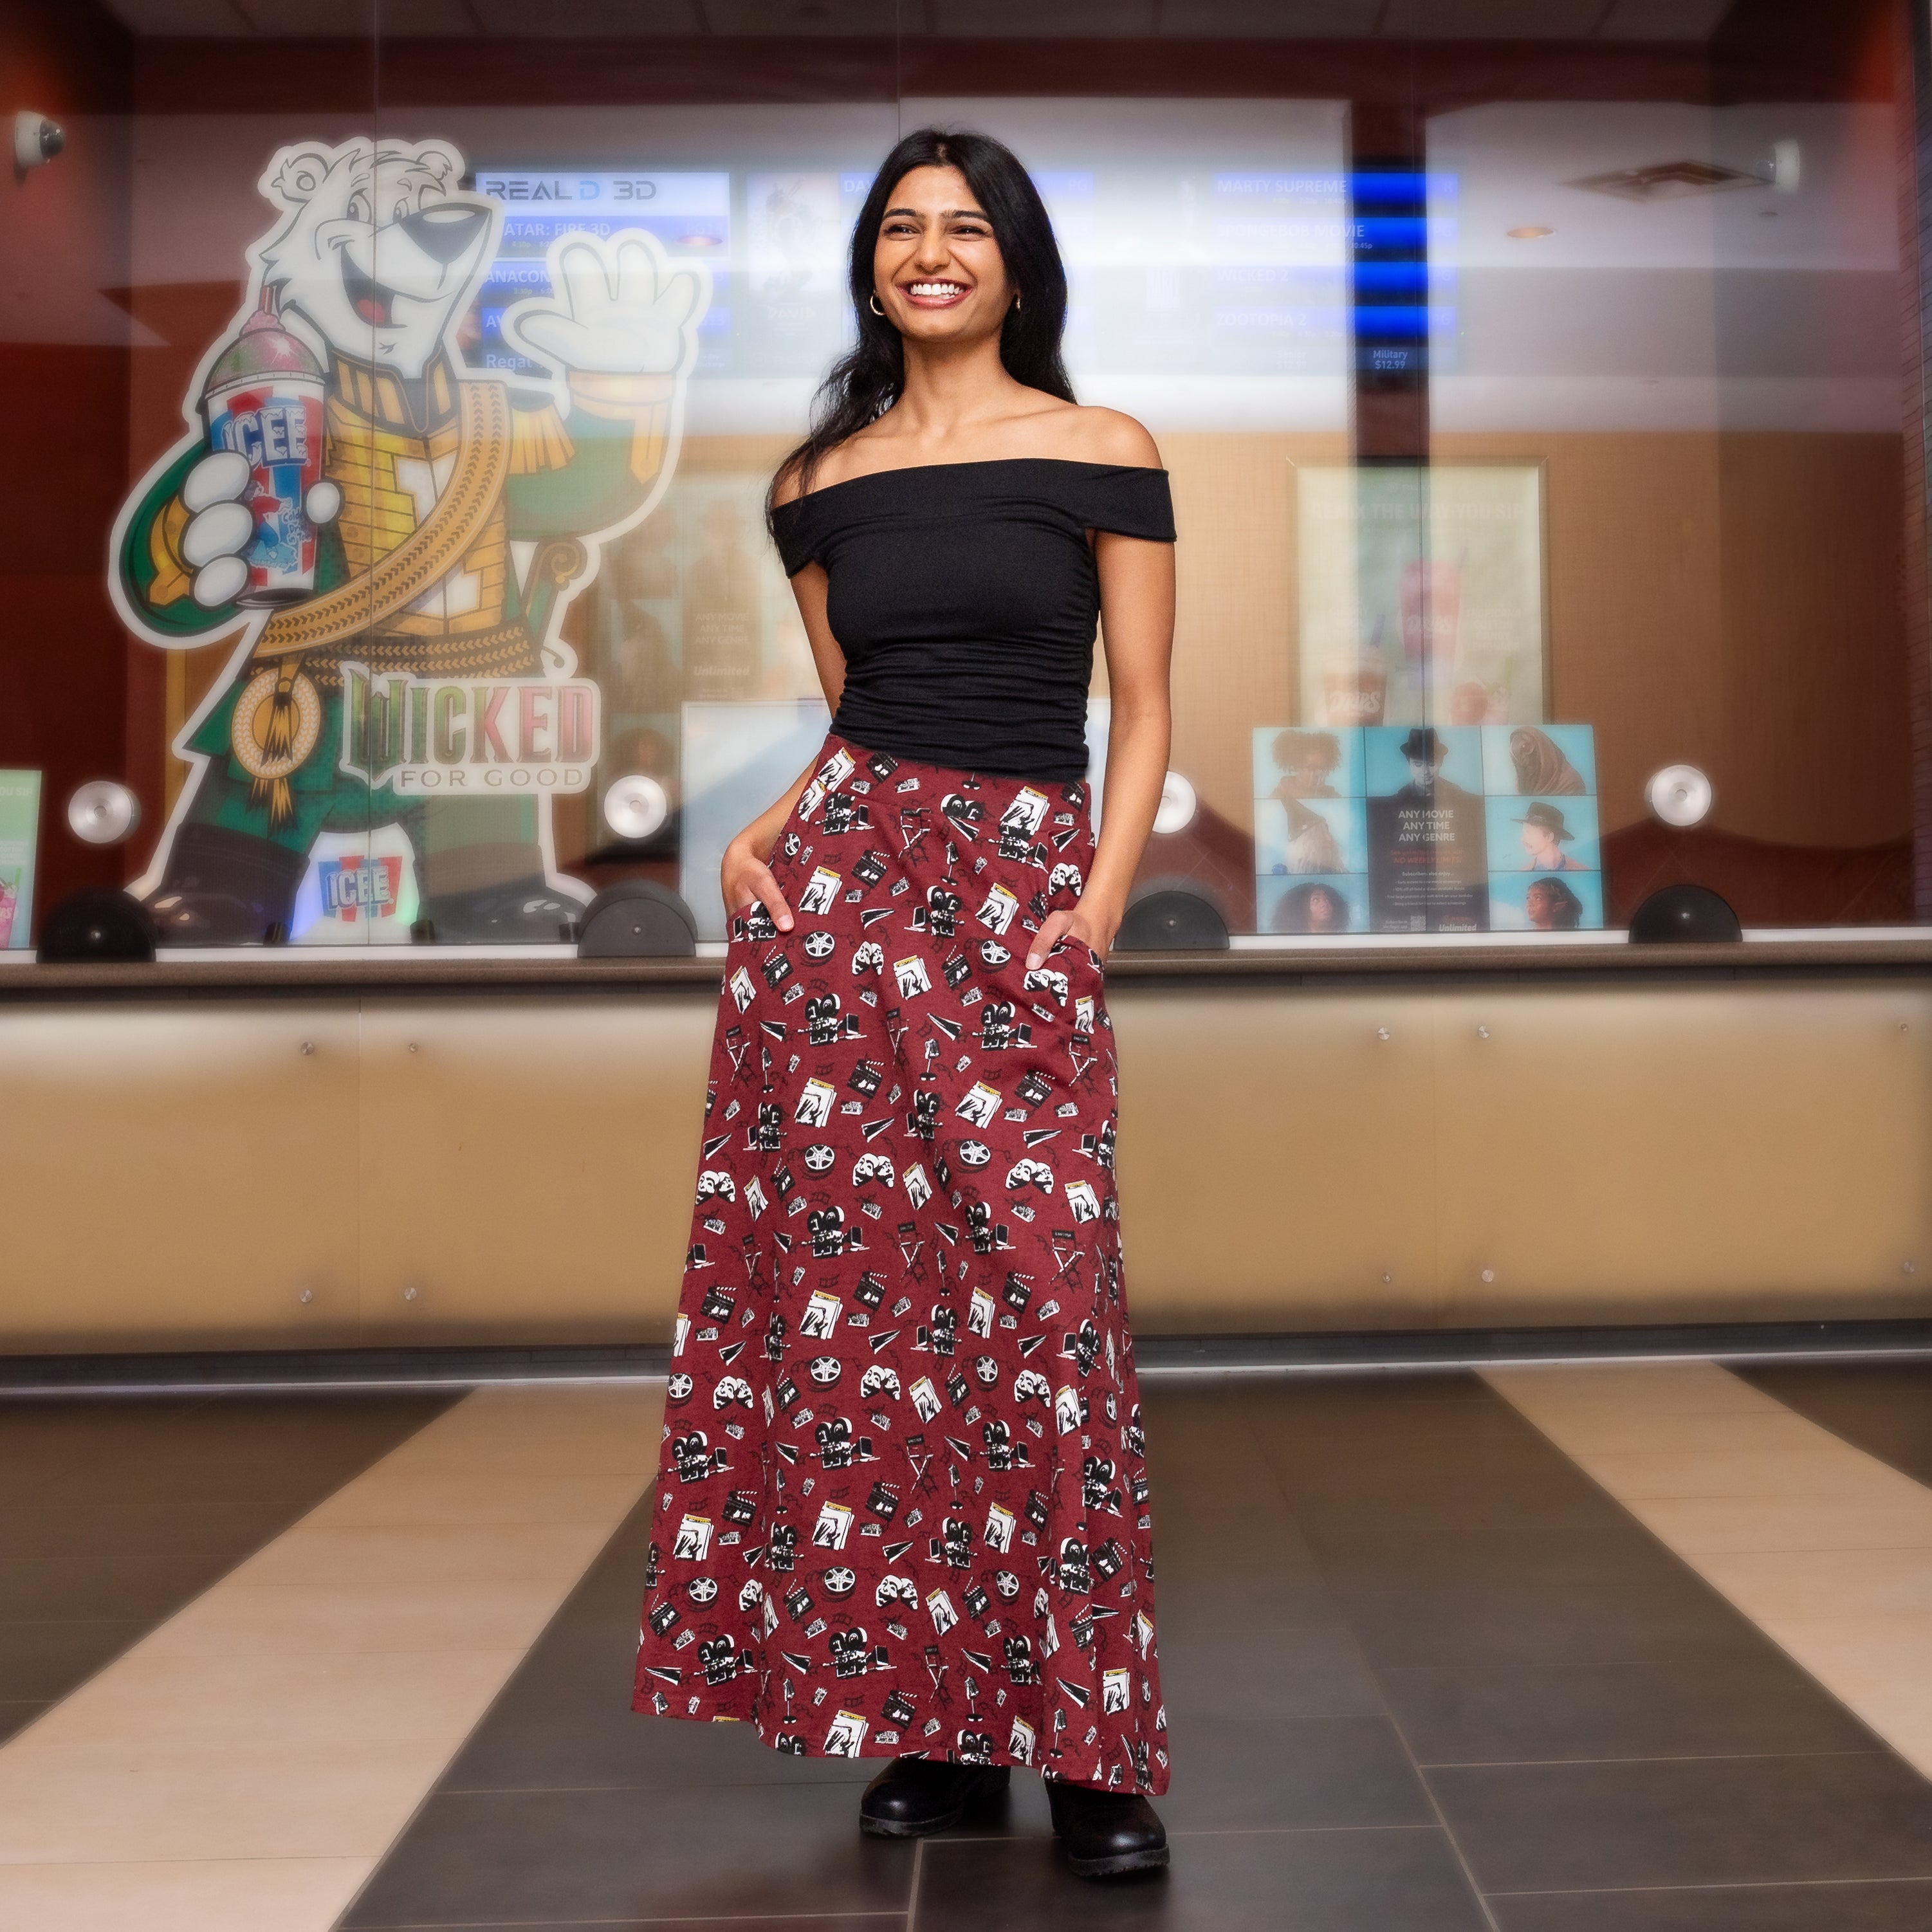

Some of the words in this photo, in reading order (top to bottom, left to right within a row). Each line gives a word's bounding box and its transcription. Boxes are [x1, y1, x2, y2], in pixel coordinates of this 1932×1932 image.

[486, 181, 572, 200] REAL
[613, 181, 656, 200] 3D
[1218, 180, 1271, 192] MARTY
[1276, 180, 1347, 192] SUPREME
[504, 223, 549, 236] ATAR:
[1218, 226, 1311, 237] SPONGEBOB
[1314, 226, 1365, 237] MOVIE
[485, 270, 551, 282] ANACON
[1217, 269, 1276, 281] WICKED
[1281, 269, 1289, 281] 2
[1217, 314, 1294, 326] ZOOTOPIA
[1298, 313, 1307, 326] 2
[1373, 350, 1408, 360] Military
[1375, 360, 1406, 370] $12.99
[221, 406, 308, 468] ICEE
[349, 668, 594, 780] WICKED
[400, 769, 468, 788] FOR
[484, 768, 584, 787] GOOD
[1398, 810, 1421, 819] ANY
[1422, 809, 1454, 818] MOVIE
[1403, 822, 1424, 830] ANY
[1426, 822, 1450, 830] TIME
[1399, 833, 1421, 842] ANY
[1422, 833, 1455, 842] GENRE
[327, 866, 391, 909] ICEE
[1439, 923, 1477, 932] Unlimited
